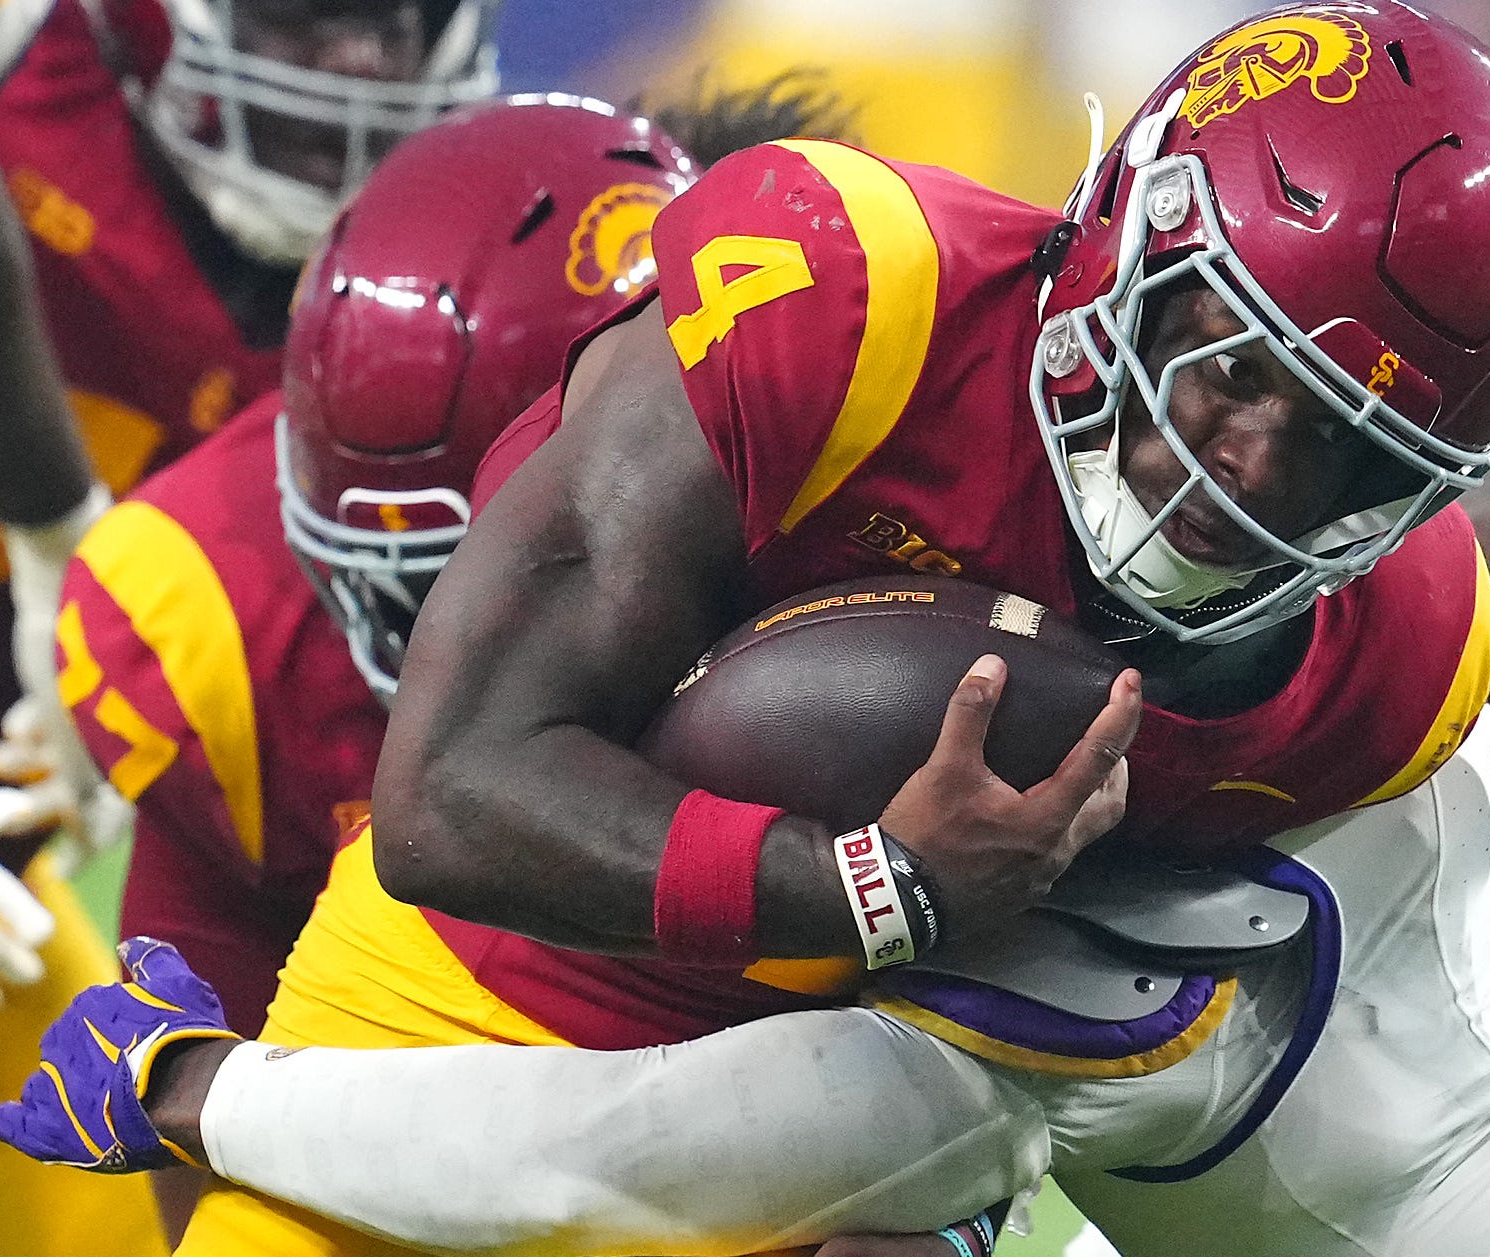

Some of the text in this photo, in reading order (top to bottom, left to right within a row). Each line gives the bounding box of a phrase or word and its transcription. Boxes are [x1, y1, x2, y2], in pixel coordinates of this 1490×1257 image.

[667, 235, 815, 371] 4
[754, 591, 935, 632] VAPOR ELITE
[913, 884, 930, 909] USC
